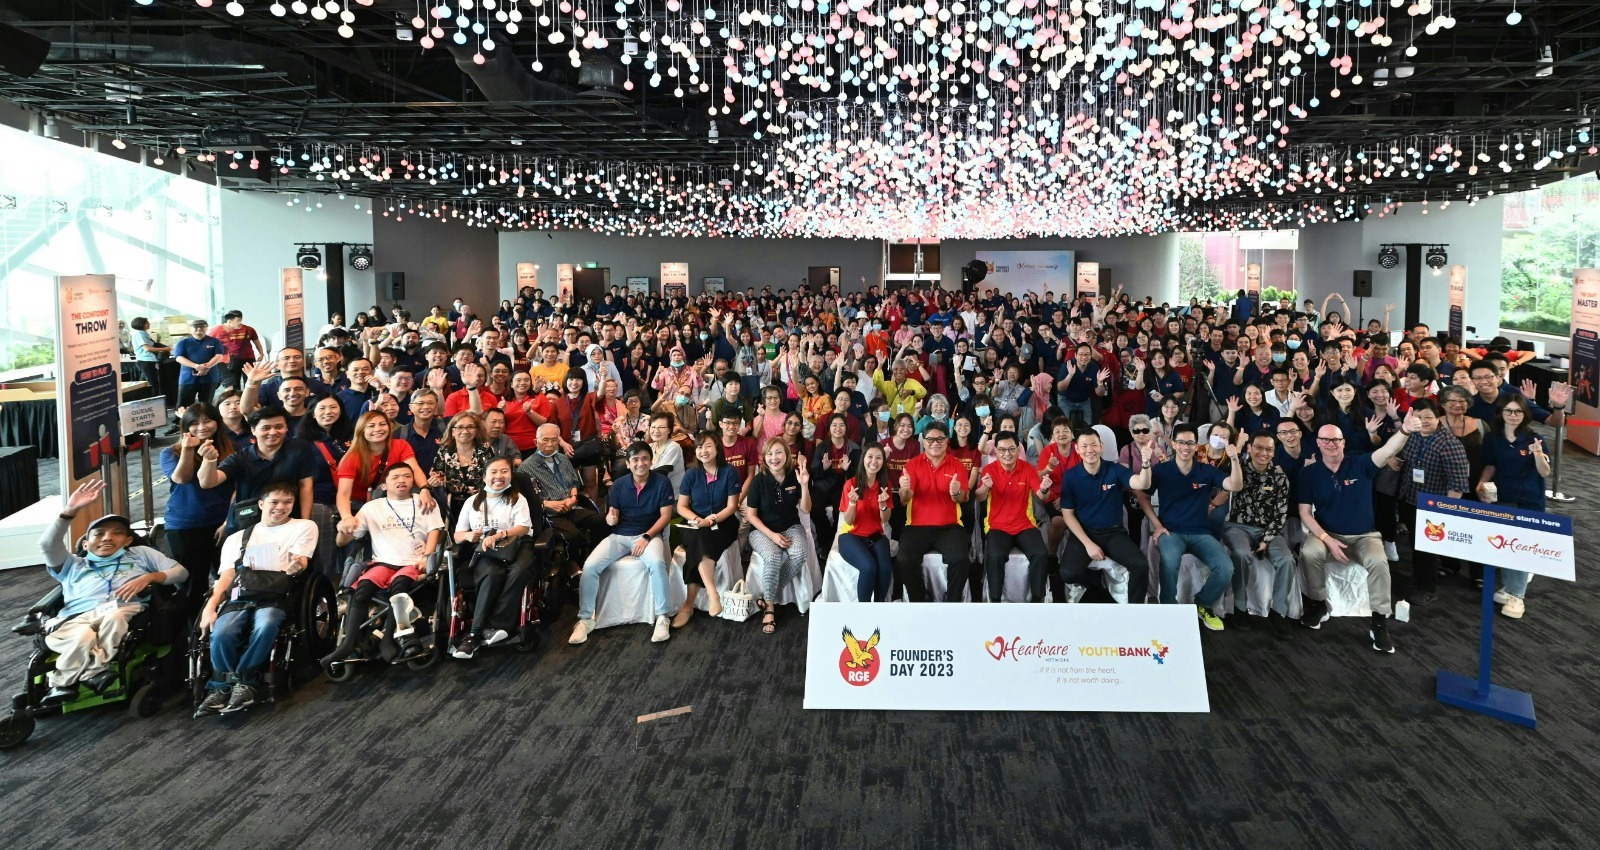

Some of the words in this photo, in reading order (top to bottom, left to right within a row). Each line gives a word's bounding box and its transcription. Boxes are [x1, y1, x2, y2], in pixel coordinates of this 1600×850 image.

[1578, 299, 1598, 308] MASTER
[83, 310, 108, 318] CONFIDENT
[76, 320, 107, 334] THROW
[132, 407, 153, 416] QUEUE
[132, 413, 155, 422] STARTS
[1471, 508, 1514, 520] community
[1516, 515, 1540, 524] starts
[1542, 519, 1560, 527] here
[1448, 531, 1472, 540] GOLDEN
[1448, 536, 1472, 544] HEARTS
[1502, 538, 1561, 557] Heartware
[1002, 636, 1068, 661] Heartware
[1078, 646, 1151, 656] YOUTHBANK
[890, 650, 954, 662] FOUNDER'S
[890, 664, 914, 676] DAY
[920, 664, 954, 676] 2023
[848, 671, 870, 682] RGE
